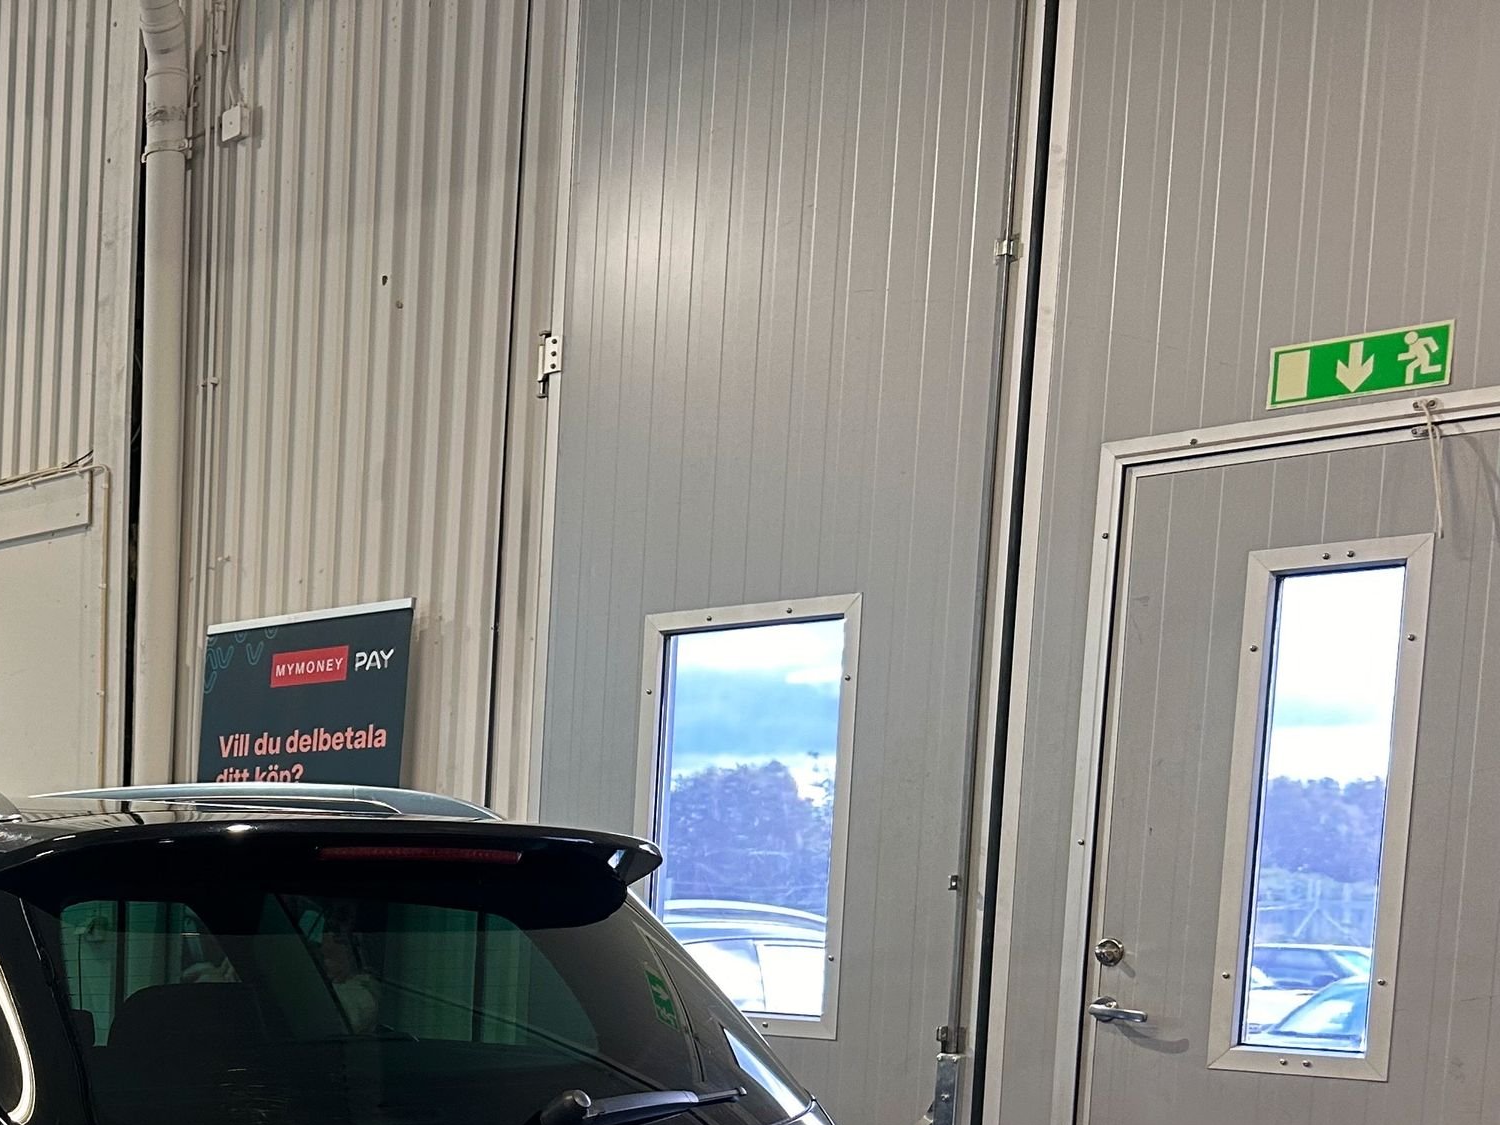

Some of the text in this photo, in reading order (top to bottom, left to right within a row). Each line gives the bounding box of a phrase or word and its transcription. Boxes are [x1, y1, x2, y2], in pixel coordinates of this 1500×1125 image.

[275, 648, 395, 677] MYMONEY PAY
[219, 723, 387, 758] Vill du delbetala
[216, 766, 250, 783] ditt
